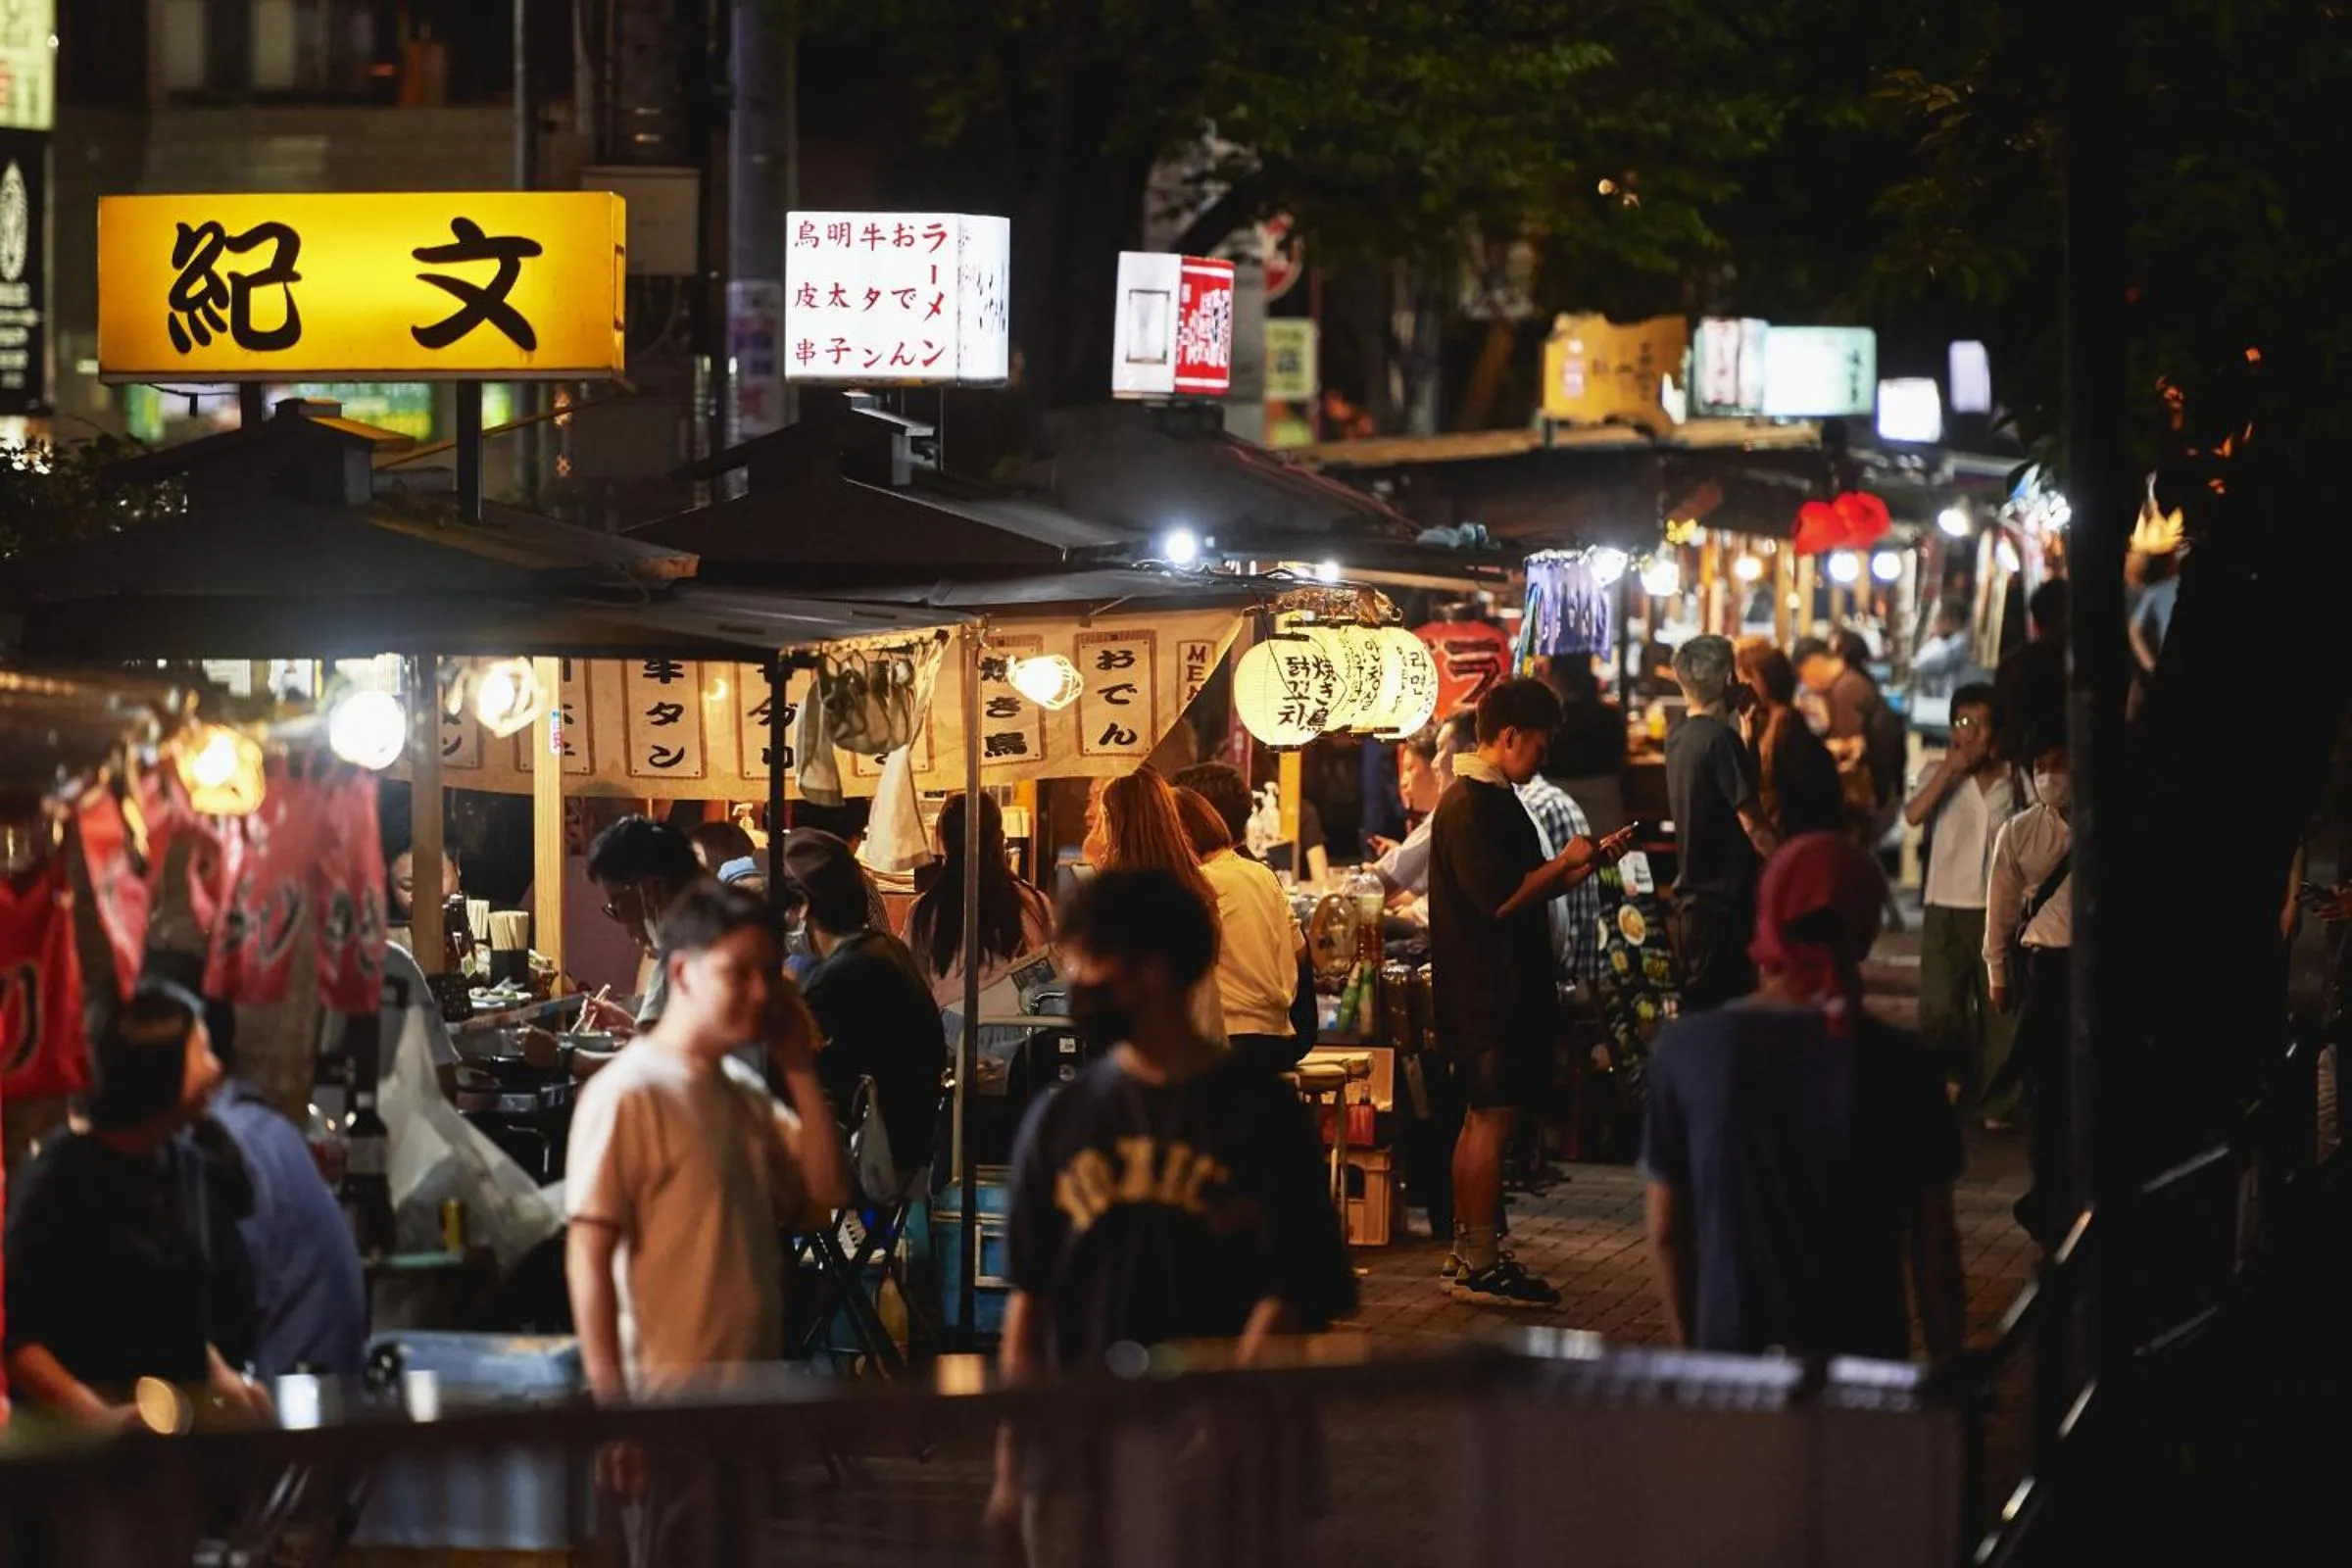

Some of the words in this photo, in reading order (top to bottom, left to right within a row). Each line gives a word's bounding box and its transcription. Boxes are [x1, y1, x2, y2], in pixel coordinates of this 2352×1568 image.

[168, 217, 543, 354] 紀文
[825, 221, 853, 366] 明太子
[859, 222, 887, 368] 牛タン
[889, 222, 917, 367] おでん
[921, 222, 949, 367] ラーメン
[1096, 650, 1138, 746] おでん
